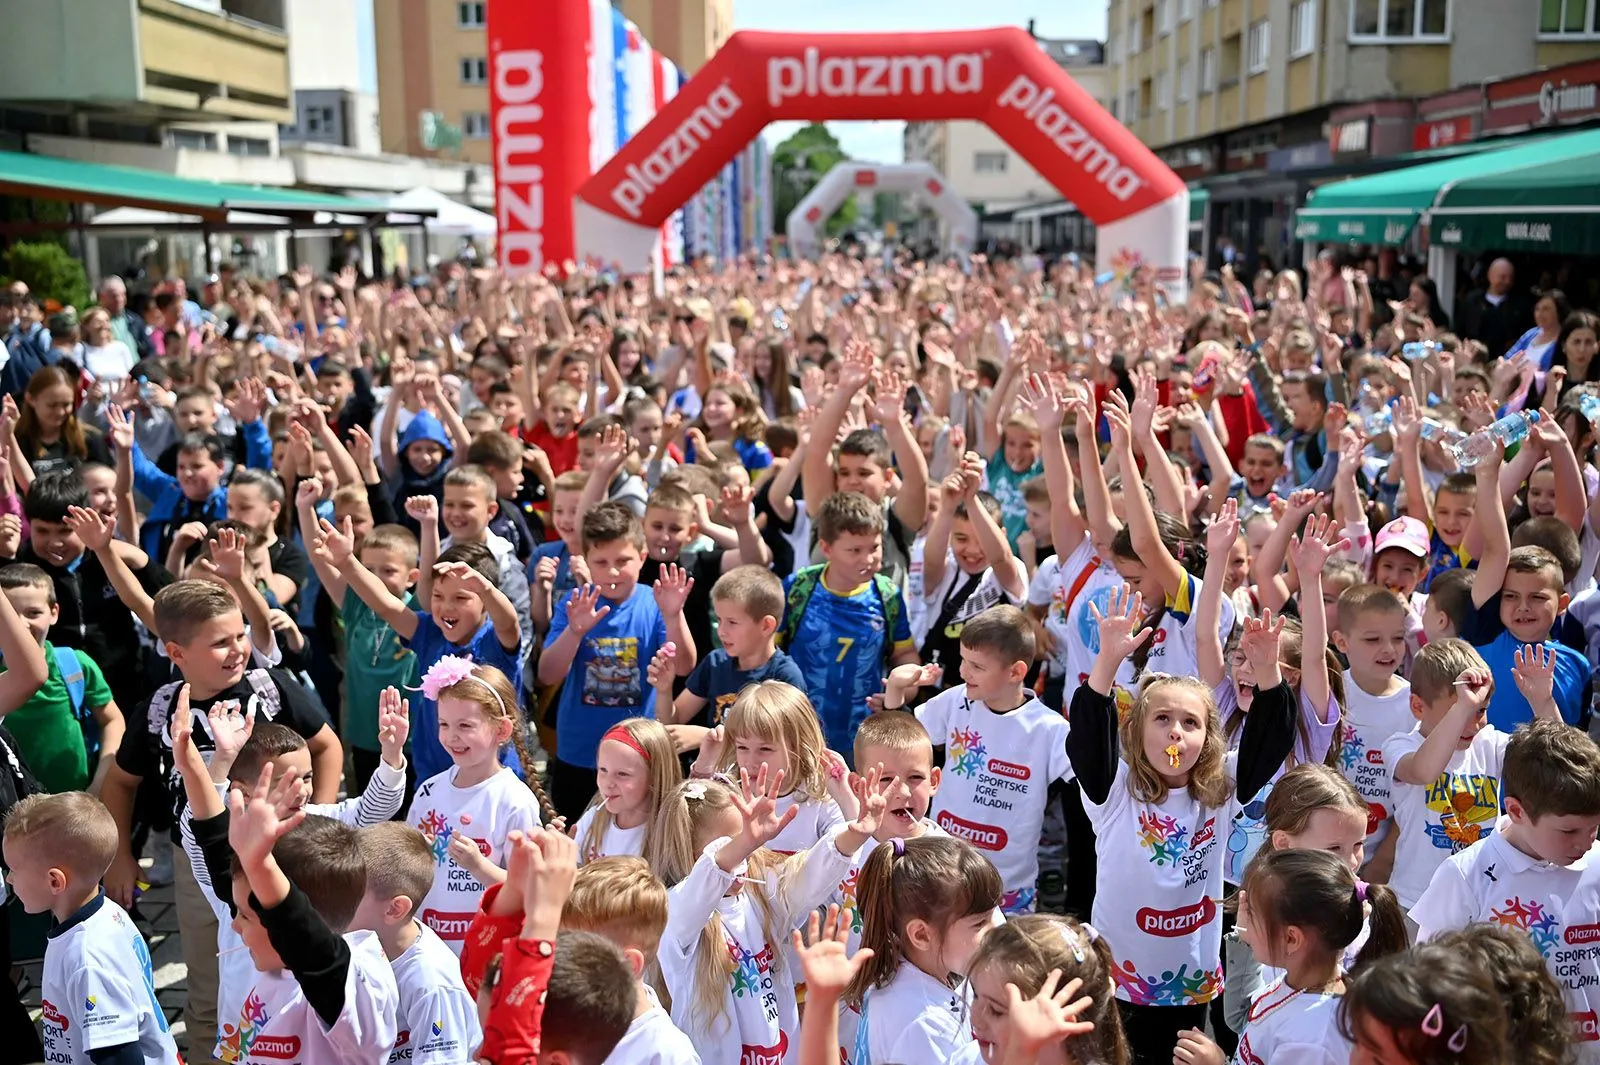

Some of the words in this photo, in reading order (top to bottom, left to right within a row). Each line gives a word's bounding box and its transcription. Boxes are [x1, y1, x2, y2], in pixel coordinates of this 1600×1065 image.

[767, 46, 984, 107] plazma
[996, 74, 1142, 201] plazma
[611, 84, 742, 218] plazma
[495, 49, 544, 278] azma
[836, 637, 854, 662] 7
[991, 762, 1026, 777] plazma
[1357, 765, 1387, 777] SPORT
[975, 784, 998, 797] IGRE
[978, 773, 1028, 794] SPORTSKE
[1355, 775, 1376, 786] IGRE
[973, 795, 1012, 811] MLADIH
[940, 816, 998, 845] plazma
[1184, 869, 1208, 889] MLAD
[1568, 928, 1600, 942] plazm
